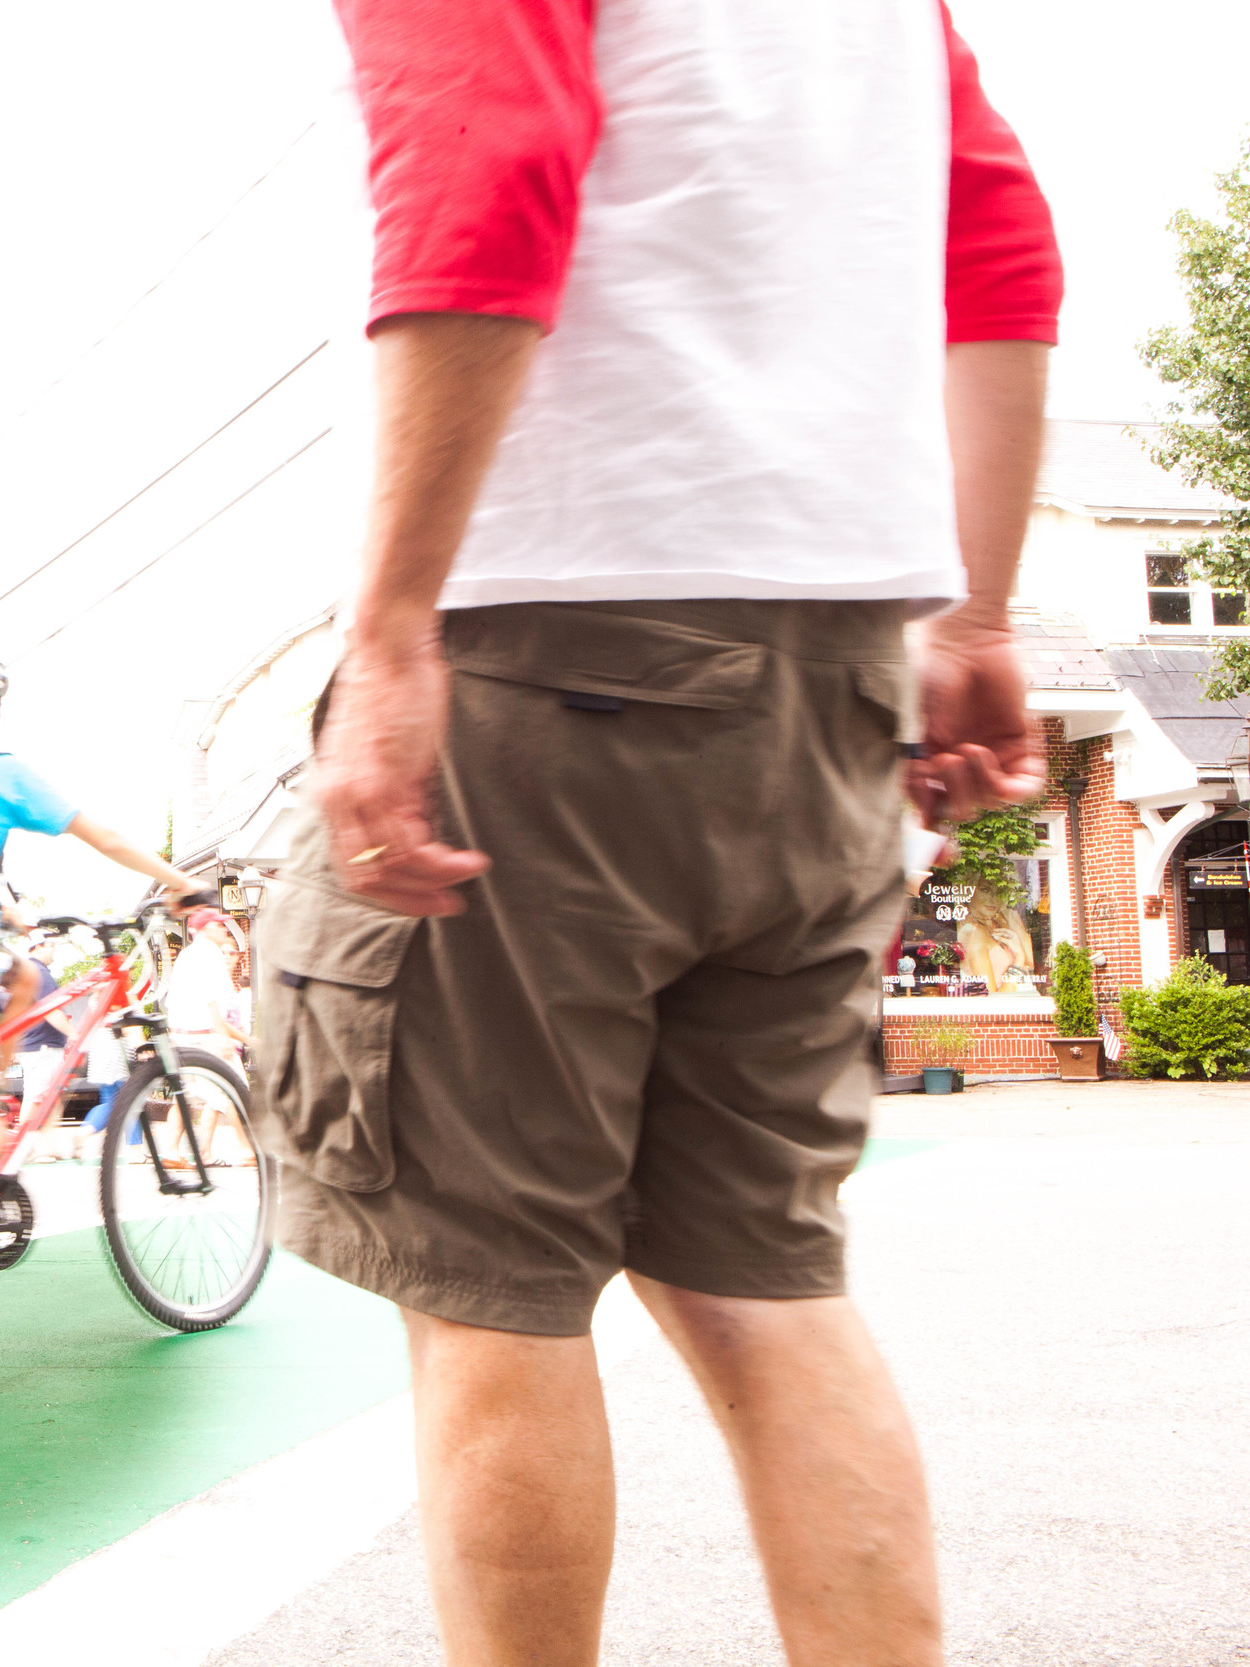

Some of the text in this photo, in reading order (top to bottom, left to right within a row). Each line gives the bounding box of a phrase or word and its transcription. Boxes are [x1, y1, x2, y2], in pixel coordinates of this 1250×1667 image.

[924, 883, 976, 897] Jewelry
[931, 895, 971, 904] Boutique
[920, 975, 950, 984] LAUREN
[961, 975, 989, 984] ADAMS
